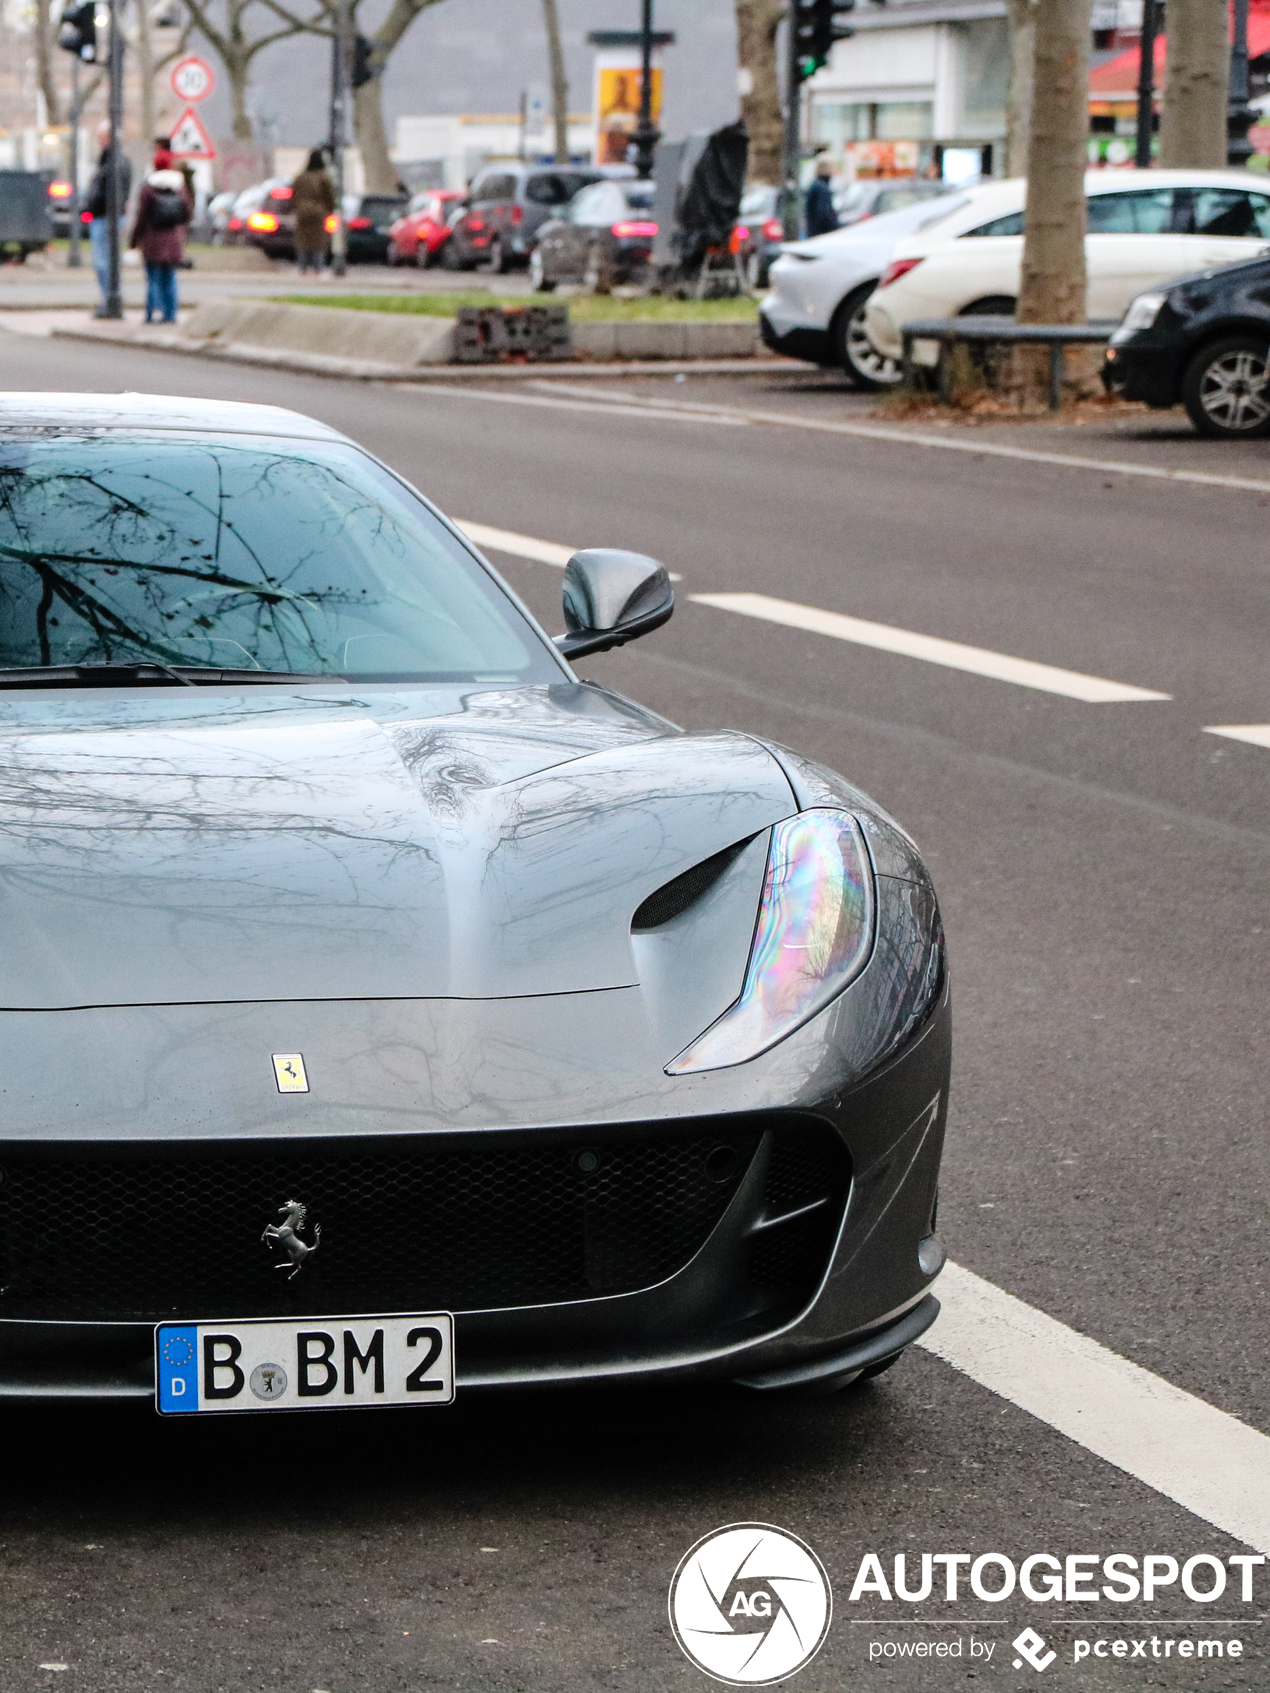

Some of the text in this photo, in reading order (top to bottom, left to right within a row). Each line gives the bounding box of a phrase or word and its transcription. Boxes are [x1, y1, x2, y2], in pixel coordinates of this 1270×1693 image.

[171, 1377, 186, 1396] D
[203, 1327, 444, 1400] B BM 2
